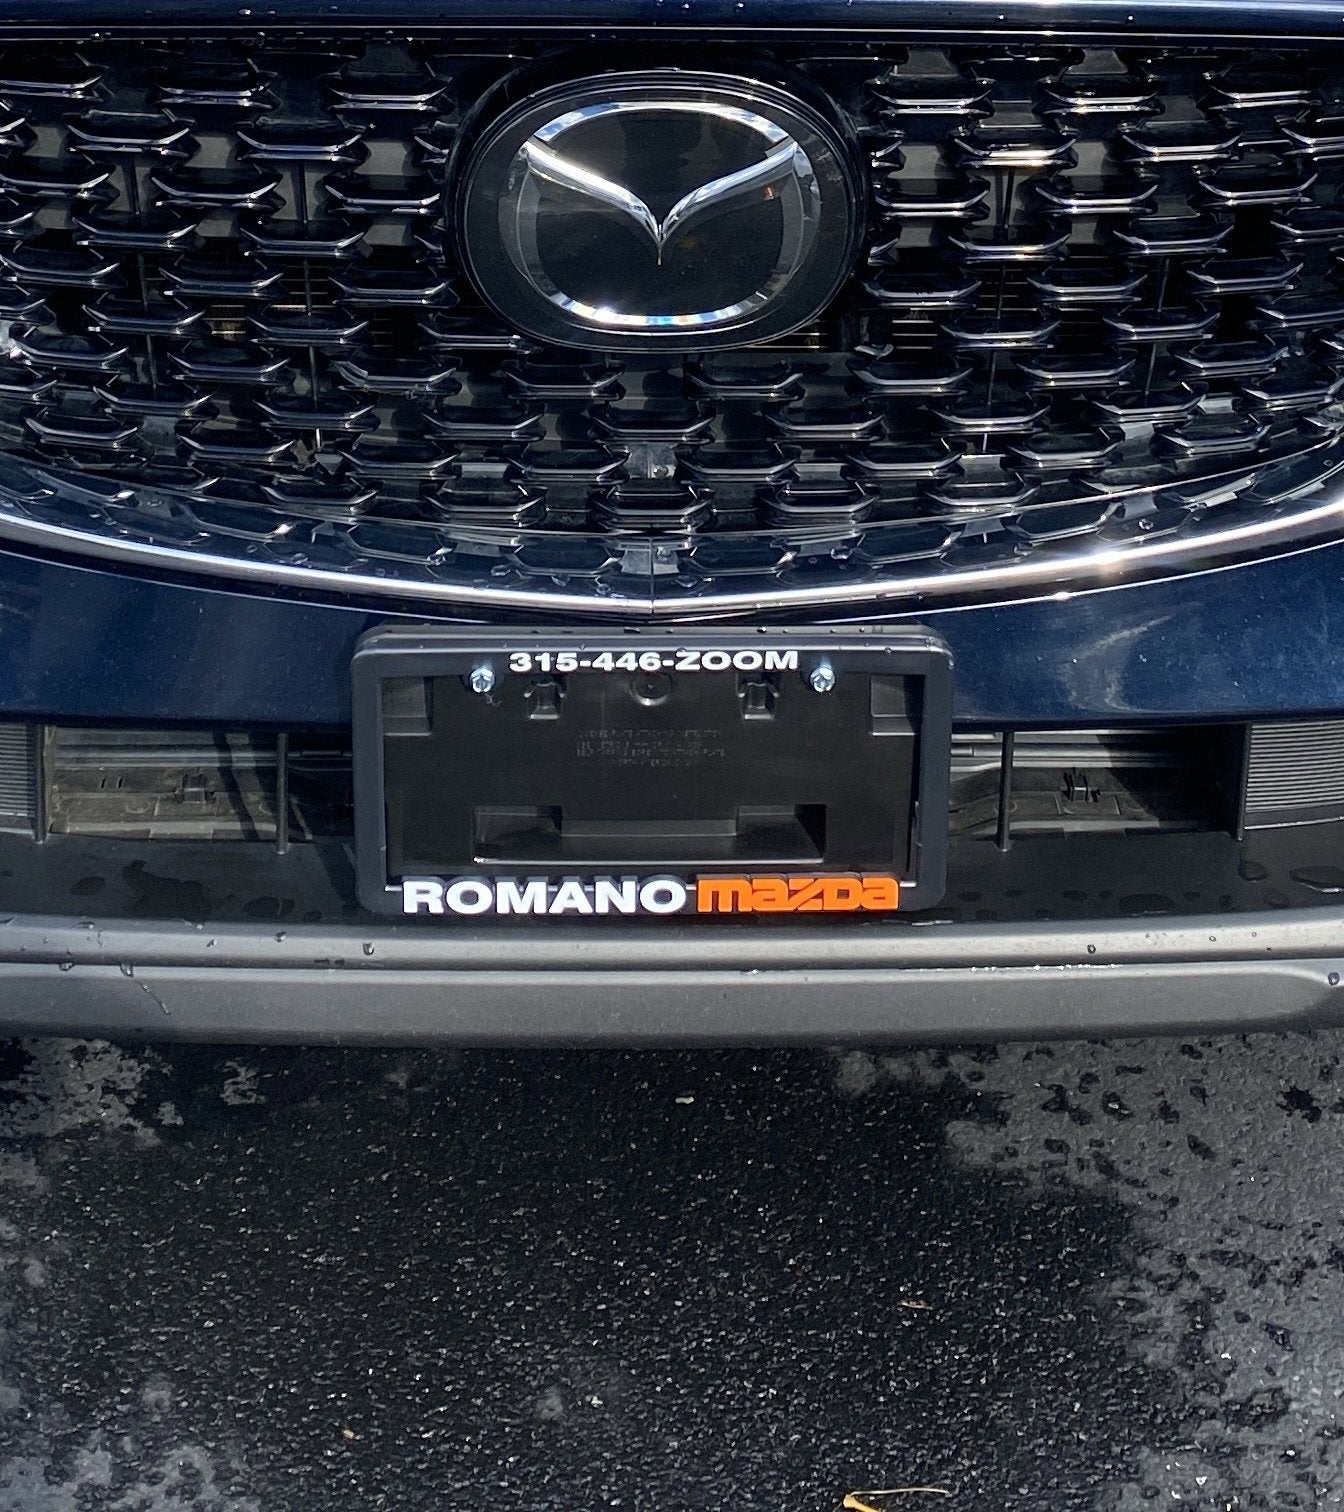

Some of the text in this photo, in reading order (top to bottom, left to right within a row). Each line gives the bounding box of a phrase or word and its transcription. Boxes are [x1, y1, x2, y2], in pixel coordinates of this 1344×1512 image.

[508, 649, 799, 672] 315-446-ZOOM
[402, 875, 900, 915] ROMANO mazda
